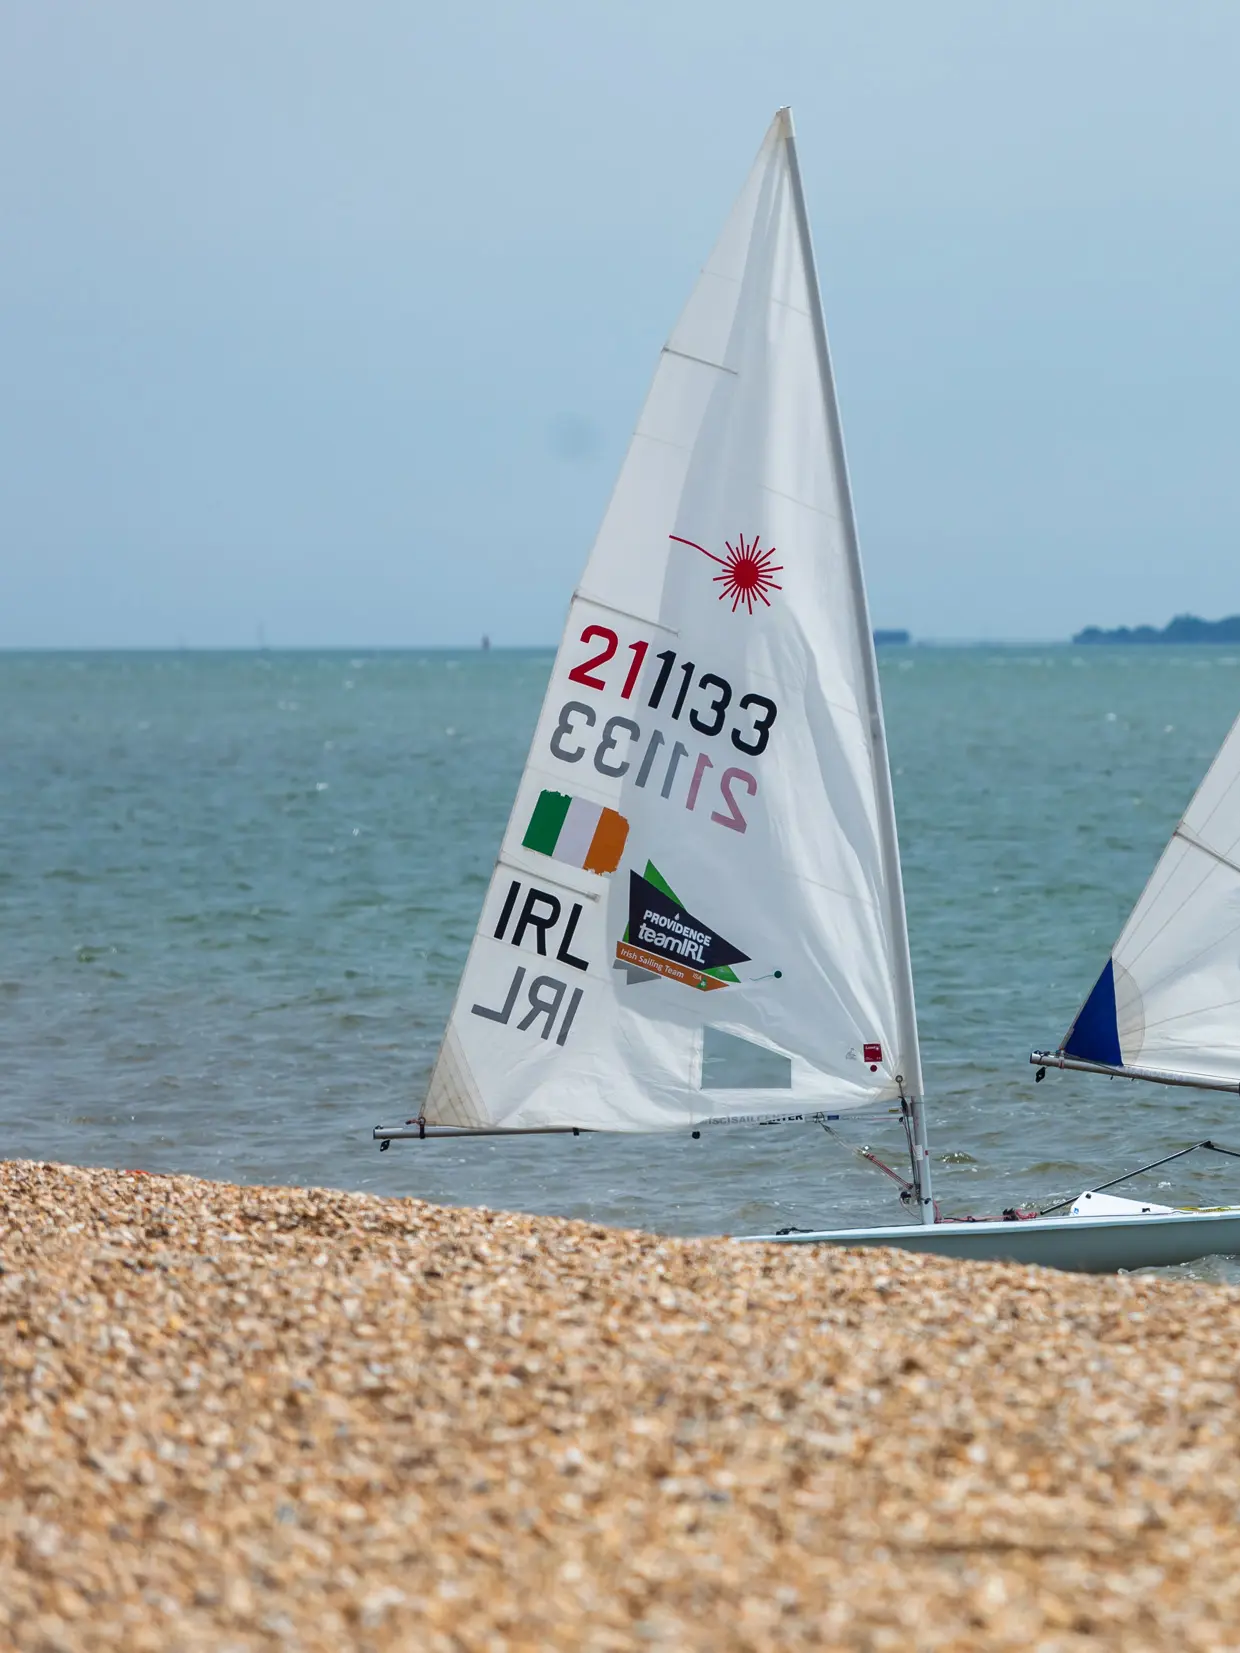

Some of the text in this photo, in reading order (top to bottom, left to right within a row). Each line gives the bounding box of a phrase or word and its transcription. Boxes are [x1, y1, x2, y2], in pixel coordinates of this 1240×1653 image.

[568, 625, 777, 756] 211133
[493, 881, 589, 971] IRL
[638, 922, 705, 964] teamIRL
[643, 909, 712, 947] PROVIDENCE
[620, 948, 685, 979] Irish Sailing Team
